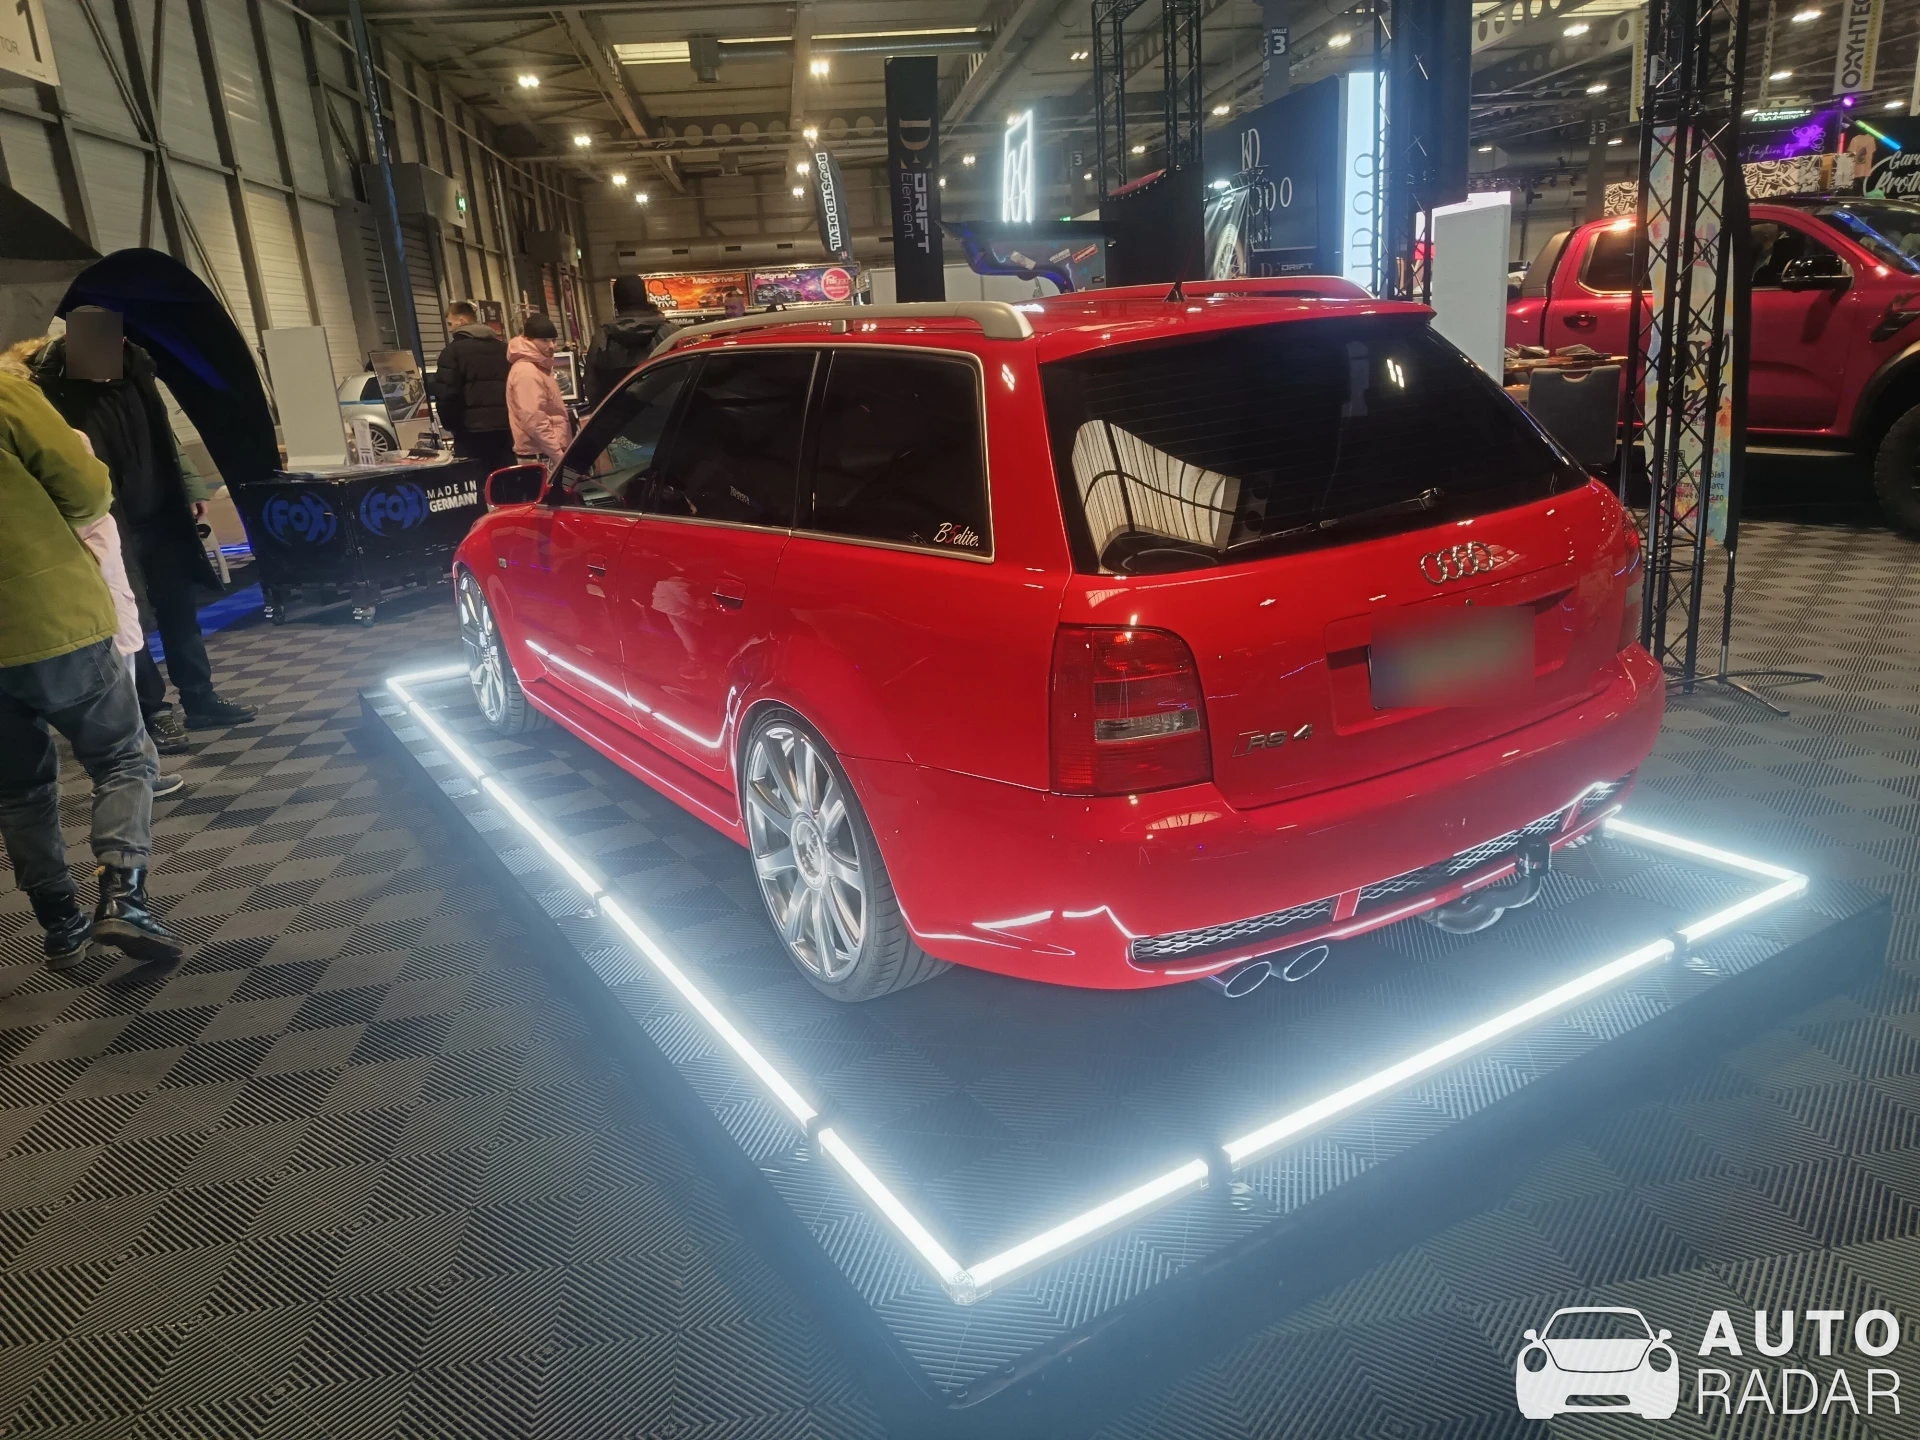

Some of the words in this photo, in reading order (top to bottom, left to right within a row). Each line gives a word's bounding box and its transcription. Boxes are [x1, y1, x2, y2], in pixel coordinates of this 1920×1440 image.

[1273, 35, 1286, 55] 3
[900, 172, 915, 240] Element
[914, 172, 930, 254] DRIFT
[1281, 263, 1314, 272] DRIFT
[427, 483, 460, 499] MADE
[464, 480, 477, 492] IN
[429, 491, 478, 513] GERMANY
[271, 495, 331, 543] FOX
[368, 483, 423, 530] FOX
[1243, 730, 1288, 753] RS
[1293, 724, 1313, 741] 4
